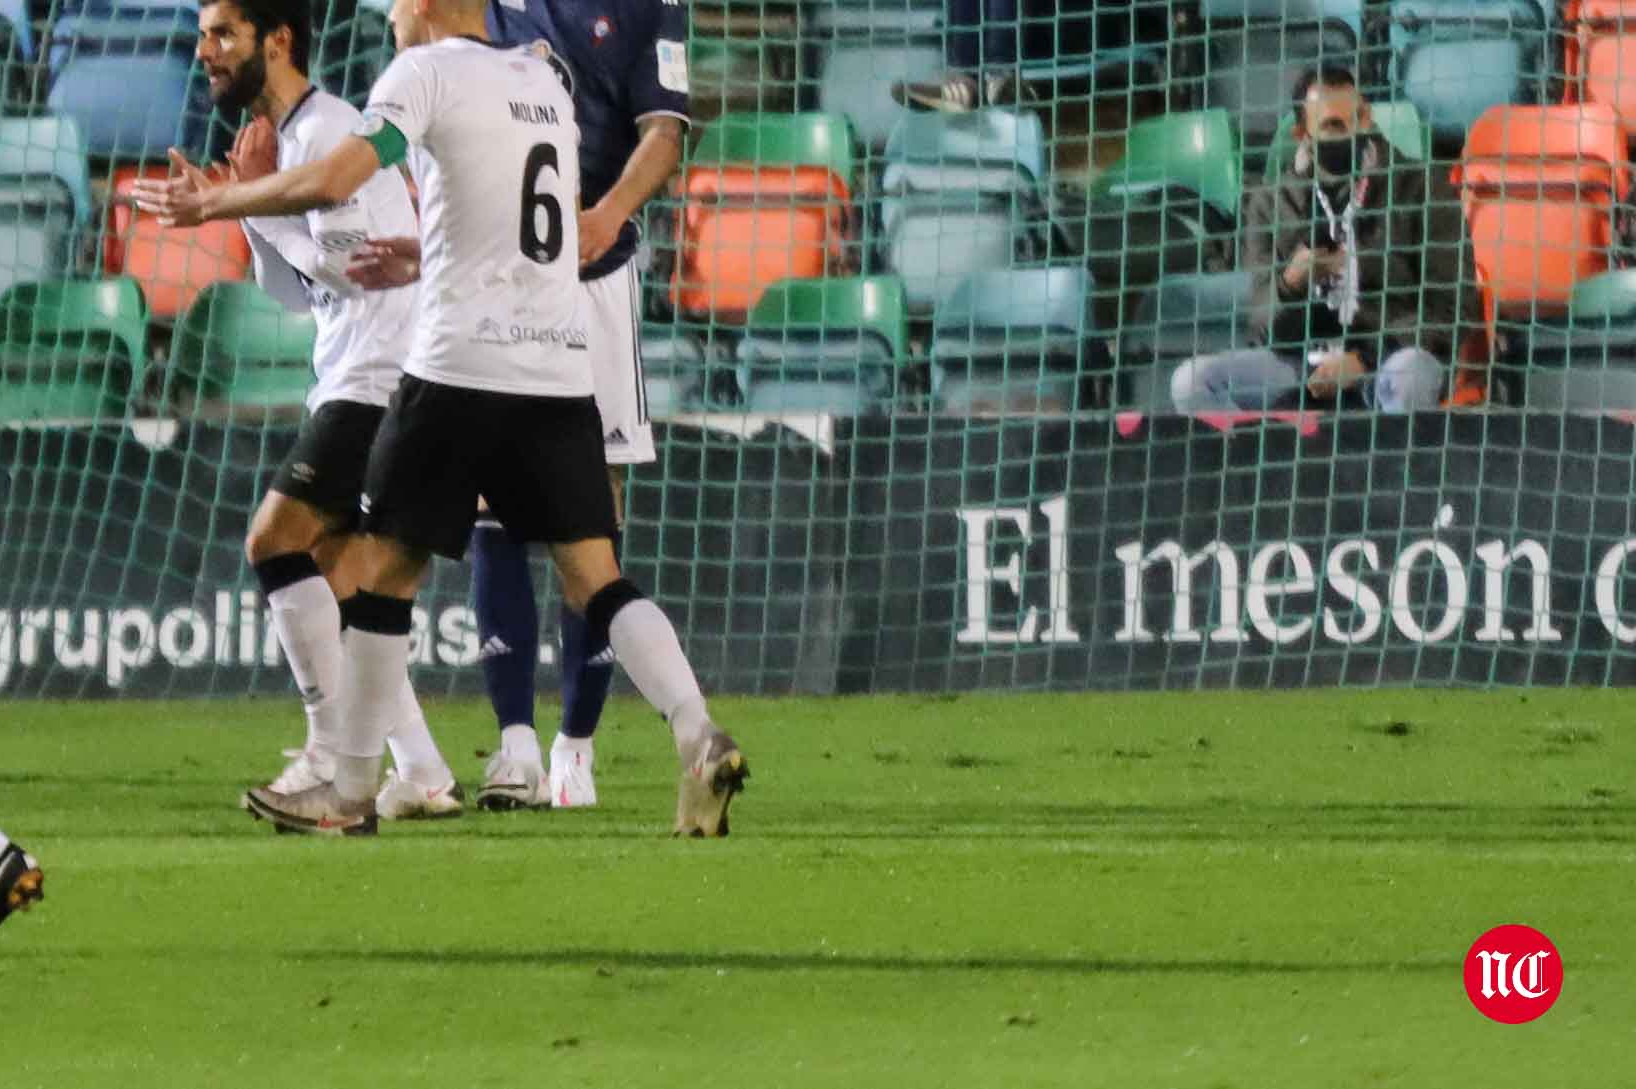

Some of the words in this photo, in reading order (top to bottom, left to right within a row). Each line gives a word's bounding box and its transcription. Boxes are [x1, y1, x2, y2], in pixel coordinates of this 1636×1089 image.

[508, 100, 560, 126] MOLINA
[519, 141, 563, 265] 6
[955, 495, 1080, 642] El
[1115, 504, 1562, 643] mesón
